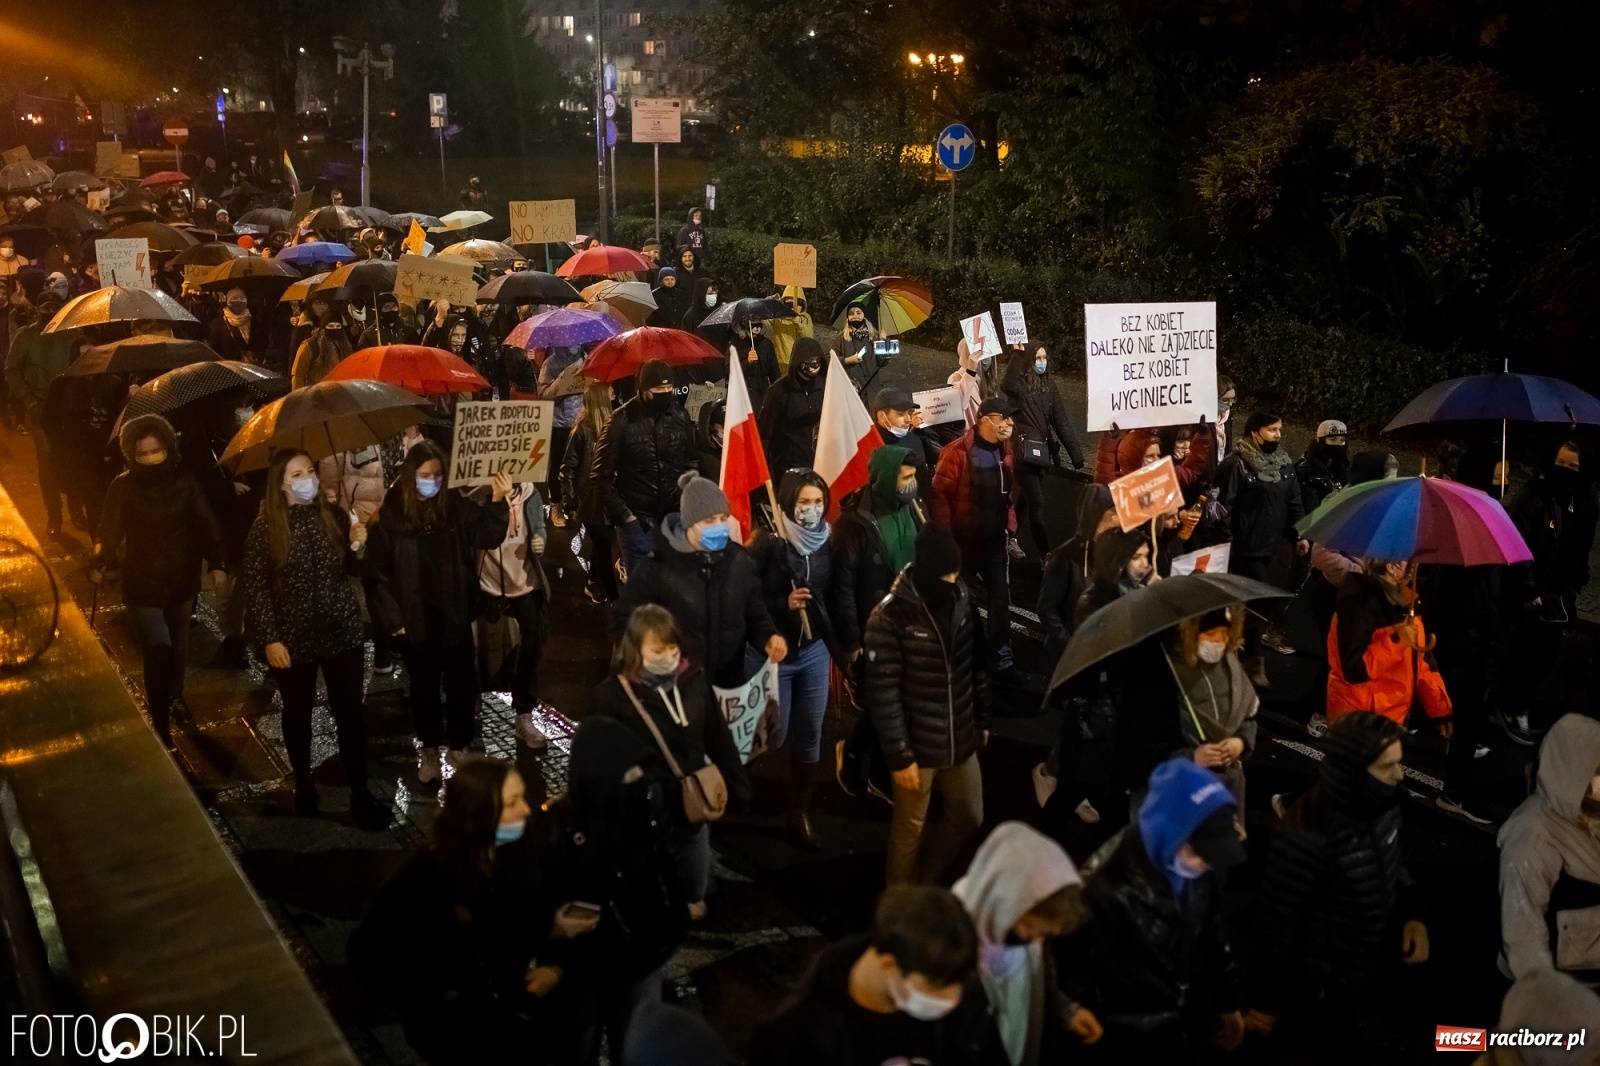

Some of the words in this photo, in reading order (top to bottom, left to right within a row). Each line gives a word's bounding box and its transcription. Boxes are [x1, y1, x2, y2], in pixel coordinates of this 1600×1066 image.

[433, 95, 443, 114] P
[511, 203, 528, 219] NO
[532, 200, 574, 217] WOMEN
[512, 224, 534, 243] NO
[113, 260, 131, 270] TAM
[1121, 316, 1142, 332] BEZ
[1146, 312, 1185, 331] KOBIET
[1090, 337, 1134, 356] DALEKO
[1138, 335, 1156, 354] NIE
[1161, 329, 1215, 359] ZAJDZIECIE
[1123, 362, 1145, 381] BEZ
[1149, 358, 1190, 378] KOBIET
[1111, 383, 1192, 411] WYGINIECIE
[458, 405, 496, 426] JAREK
[500, 405, 541, 420] ADOPTUJ
[457, 424, 493, 442] CHORE
[457, 439, 509, 459] ANDRZEJ
